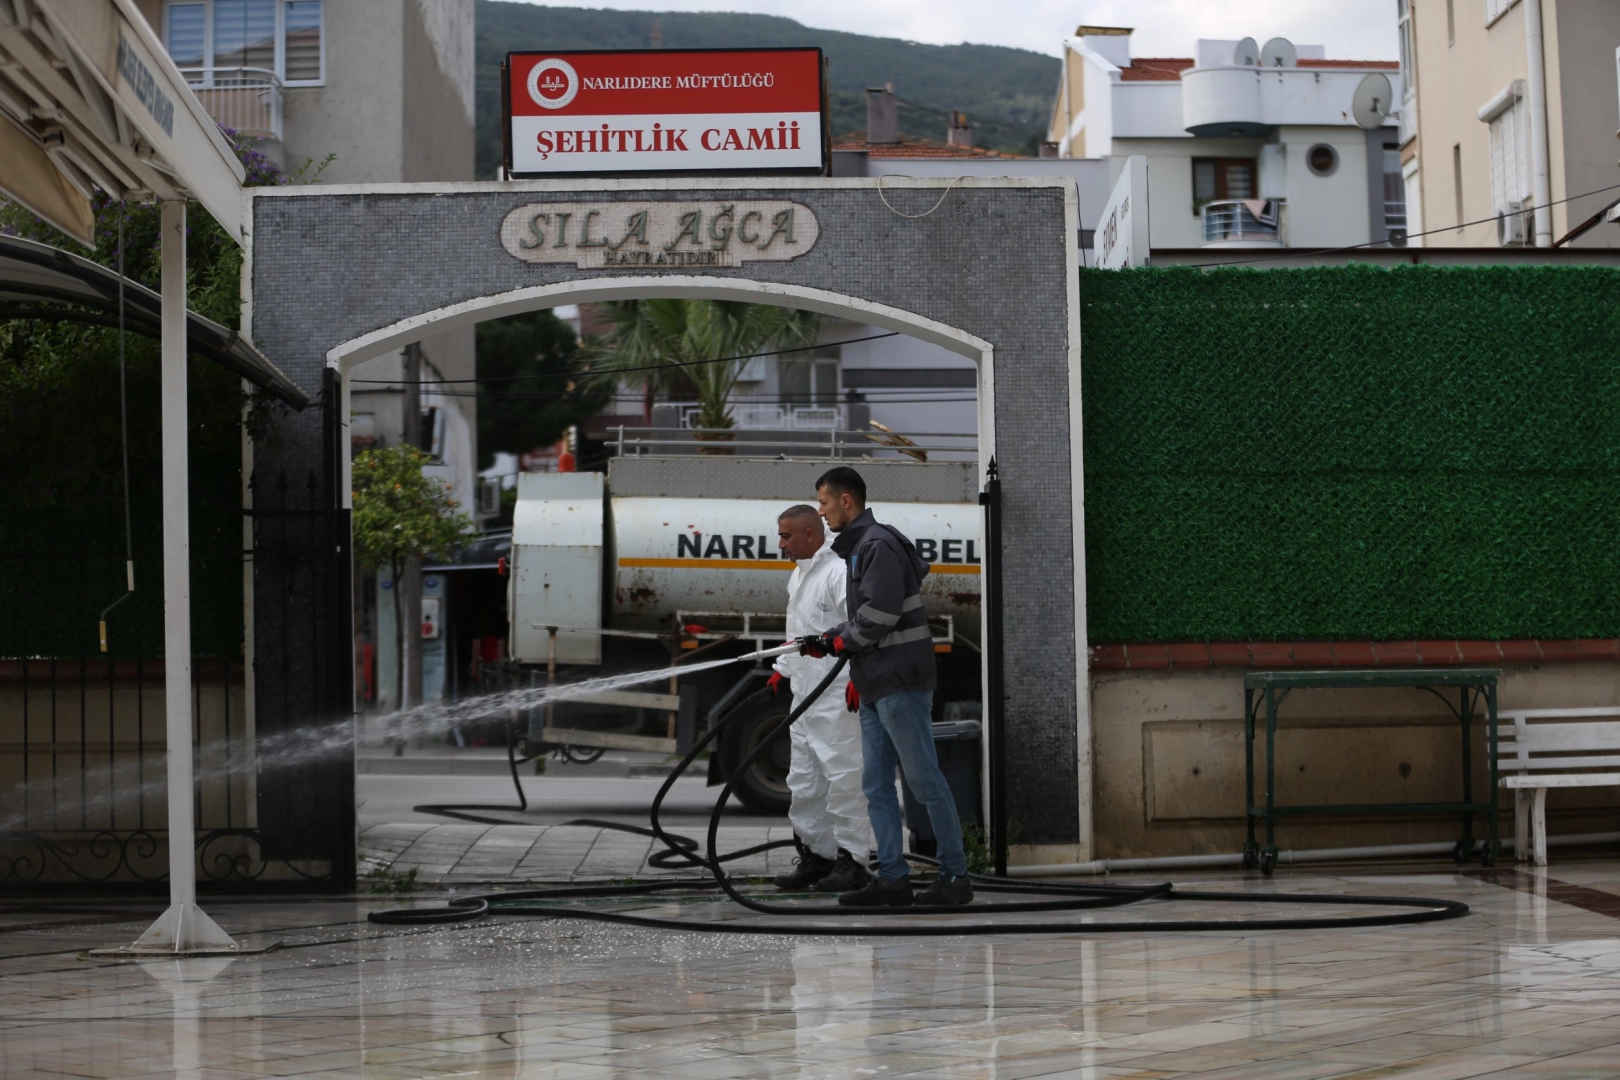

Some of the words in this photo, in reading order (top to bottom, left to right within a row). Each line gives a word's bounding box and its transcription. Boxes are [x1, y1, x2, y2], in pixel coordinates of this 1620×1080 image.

[583, 76, 672, 91] NARLIDERE
[676, 72, 775, 90] MÜFTÜLÜĞÜ
[536, 122, 689, 160] ŞEHİTLİK
[700, 120, 801, 151] CAMİİ
[519, 209, 650, 250] SILA
[663, 204, 797, 251] AĞCA
[603, 250, 718, 266] HAYRATIDIR
